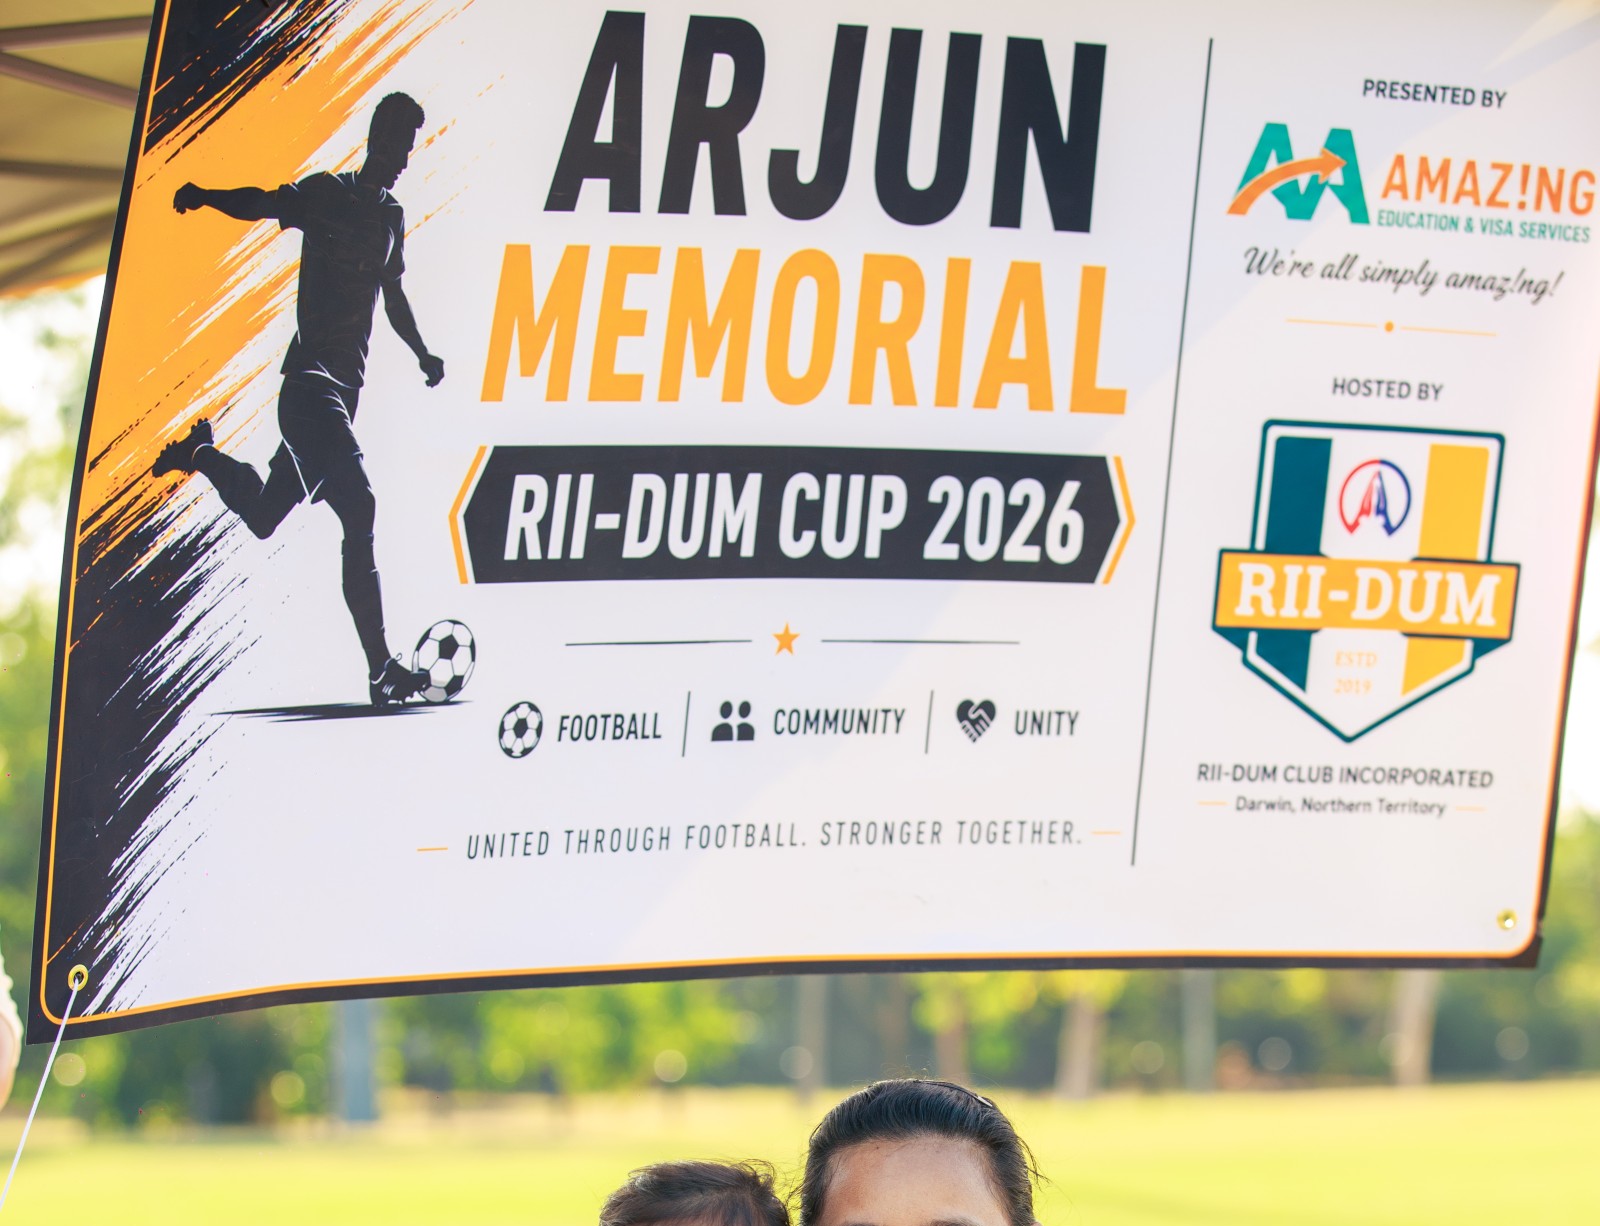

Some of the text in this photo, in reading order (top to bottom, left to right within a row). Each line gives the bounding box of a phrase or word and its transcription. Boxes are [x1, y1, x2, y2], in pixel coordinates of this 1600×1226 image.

[1363, 79, 1507, 108] PRESENTED BY
[543, 10, 1107, 233] ARJUN
[1381, 154, 1596, 216] AMAZ!NG
[1378, 210, 1590, 243] EDUCATION & VISA SERVICES
[1244, 247, 1314, 278] We're
[1320, 254, 1355, 281] all
[1358, 259, 1438, 296] simply
[480, 244, 1127, 415] MEMORIAL
[1332, 377, 1444, 400] HOSTED BY
[504, 472, 1084, 565] RII-DUM CUP 2026
[1234, 563, 1500, 626] RII-DUM
[1335, 651, 1377, 667] ESTD
[1334, 679, 1371, 694] 2019
[557, 712, 663, 742] FOOTBALL
[773, 708, 906, 736] COMMUNITY
[1014, 710, 1079, 737] UNITY
[1197, 763, 1493, 788] RII-DUM CLUB INCORPORATED
[1235, 796, 1446, 818] Darwin, Northern Territory
[466, 820, 1083, 860] UNITED THROUGH FOOTBALL. STRONGER TOGETHER.
